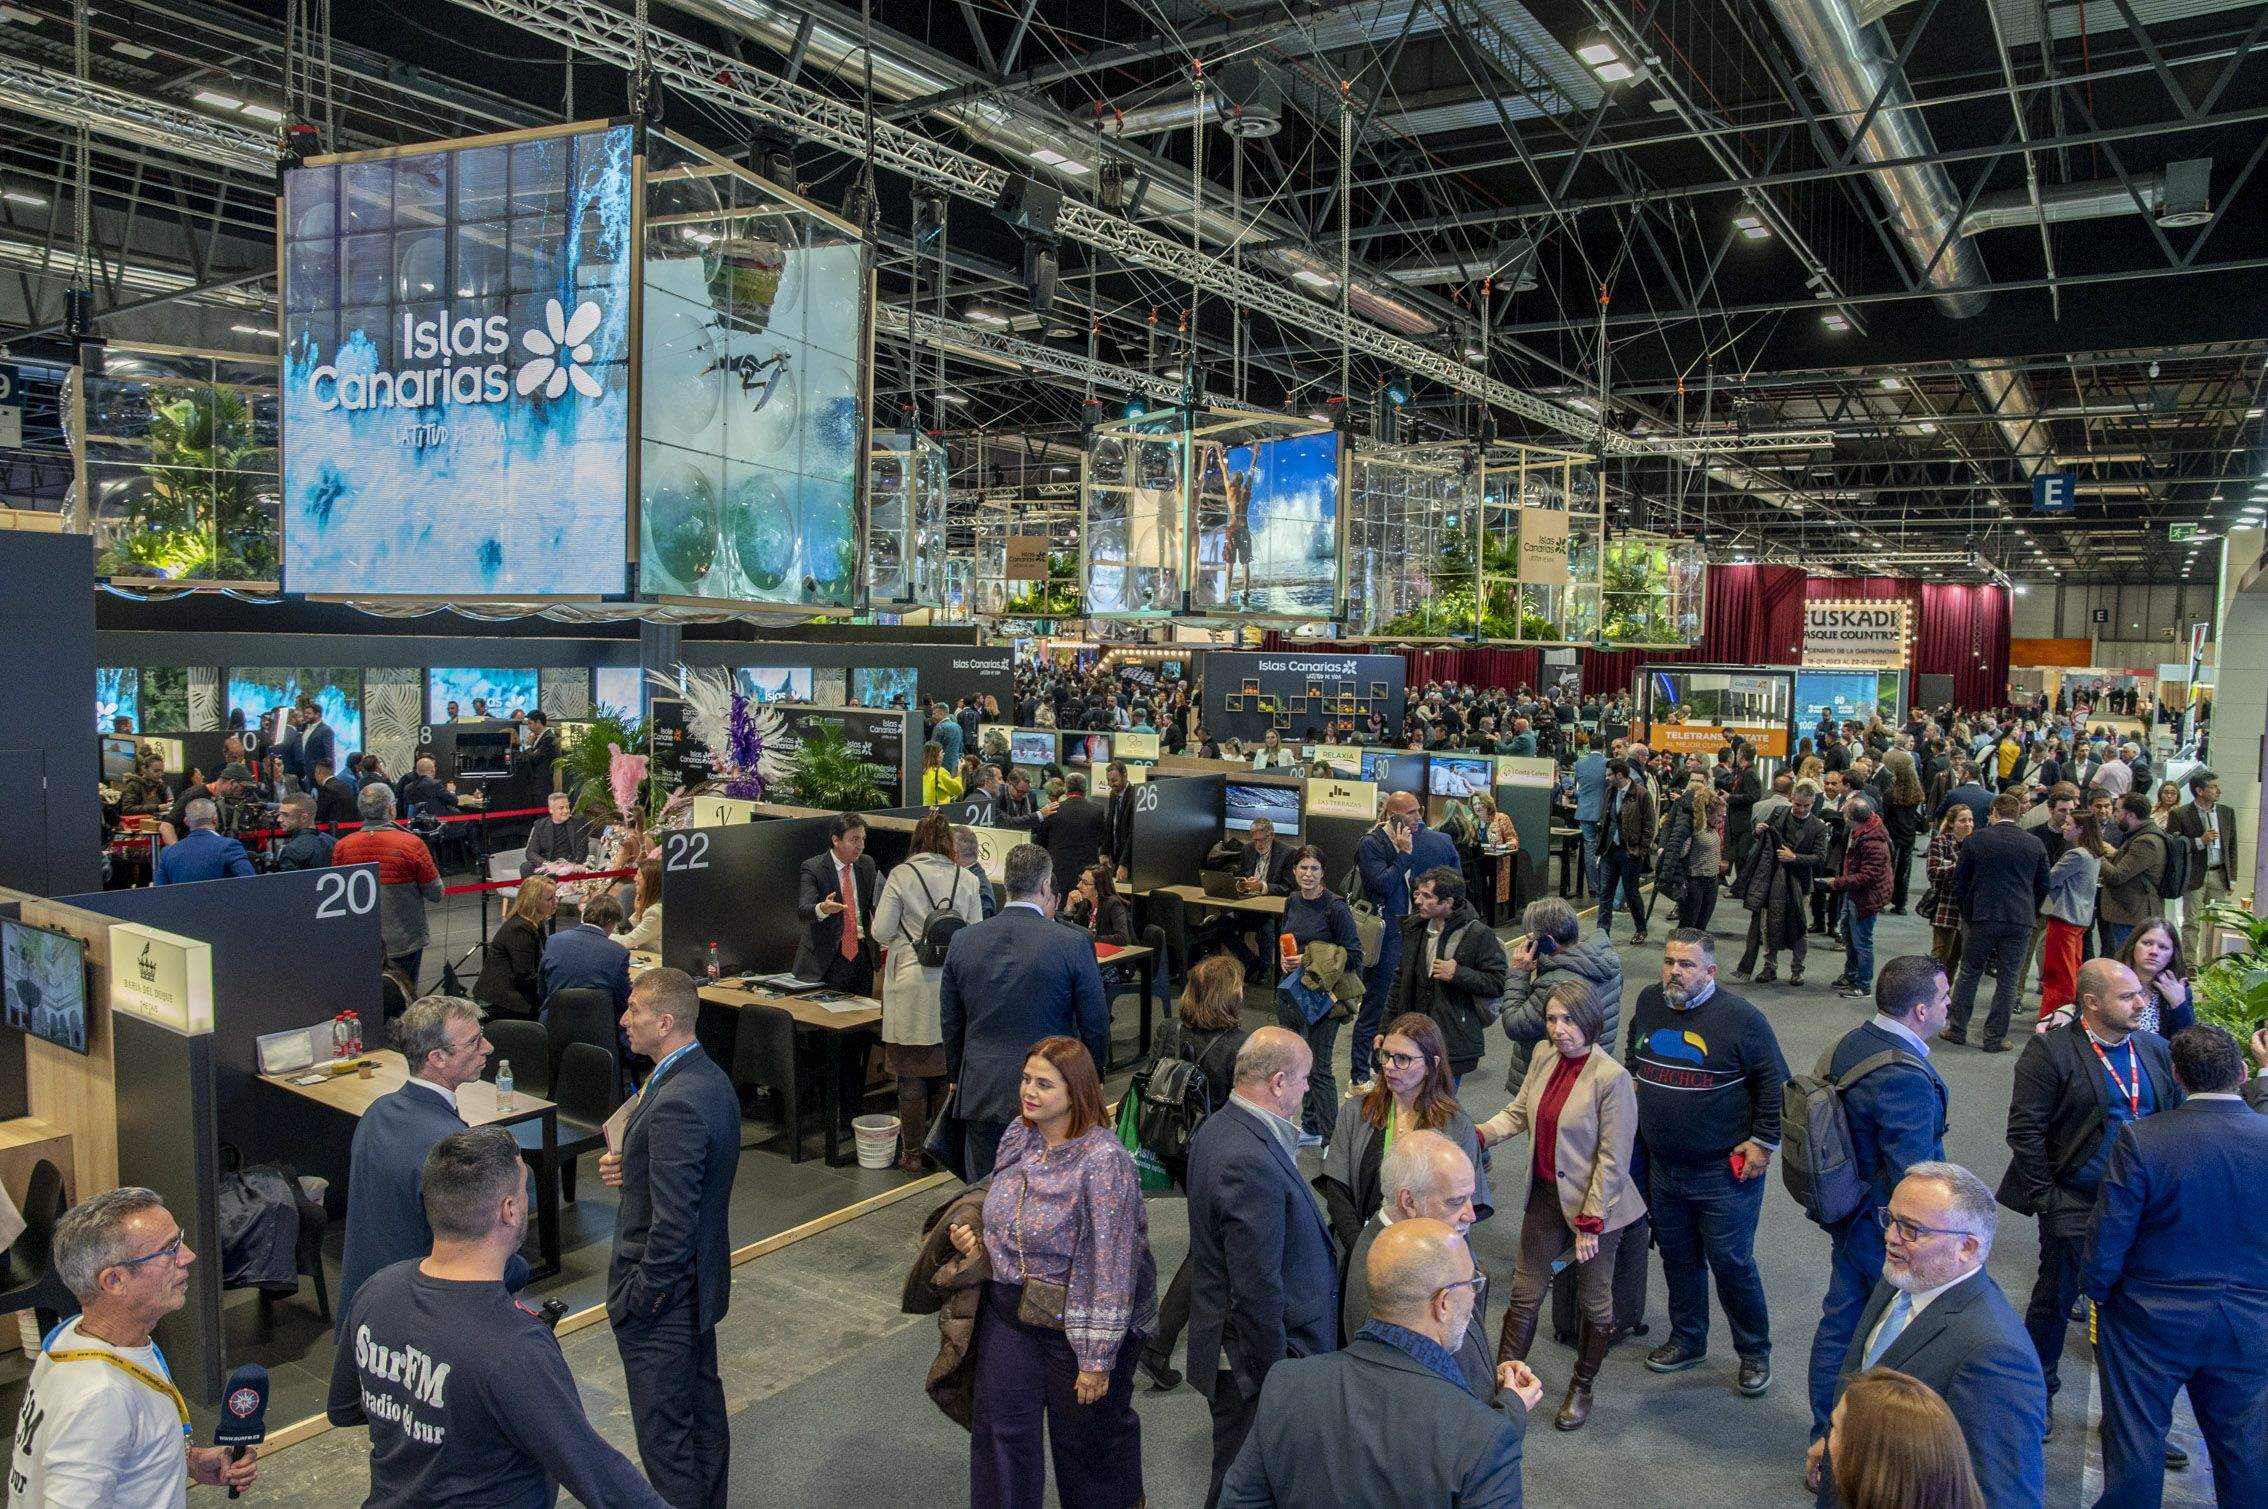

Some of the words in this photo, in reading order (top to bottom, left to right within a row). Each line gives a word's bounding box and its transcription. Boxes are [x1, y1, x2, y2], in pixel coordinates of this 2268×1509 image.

[404, 310, 510, 360] Islas
[308, 357, 510, 411] Canarias
[2044, 478, 2064, 506] E
[1523, 542, 1555, 554] Canarias
[1539, 536, 1555, 545] Islas
[1804, 610, 1896, 627] USKADI
[2096, 611, 2104, 621] E
[1840, 630, 1896, 641] COUNTRY
[953, 659, 969, 669] Islas
[970, 659, 1001, 669] Canarias
[1258, 660, 1287, 672] Islas
[1288, 660, 1342, 673] Canarias
[869, 725, 897, 734] Canarias
[882, 719, 897, 727] Islas
[420, 726, 432, 745] 8
[1375, 759, 1389, 780] 30
[1136, 784, 1159, 812] 26
[965, 803, 994, 827] 24
[667, 832, 709, 872] 22
[315, 869, 377, 919] 20
[356, 1324, 451, 1408] SurFM
[413, 1421, 445, 1444] sur
